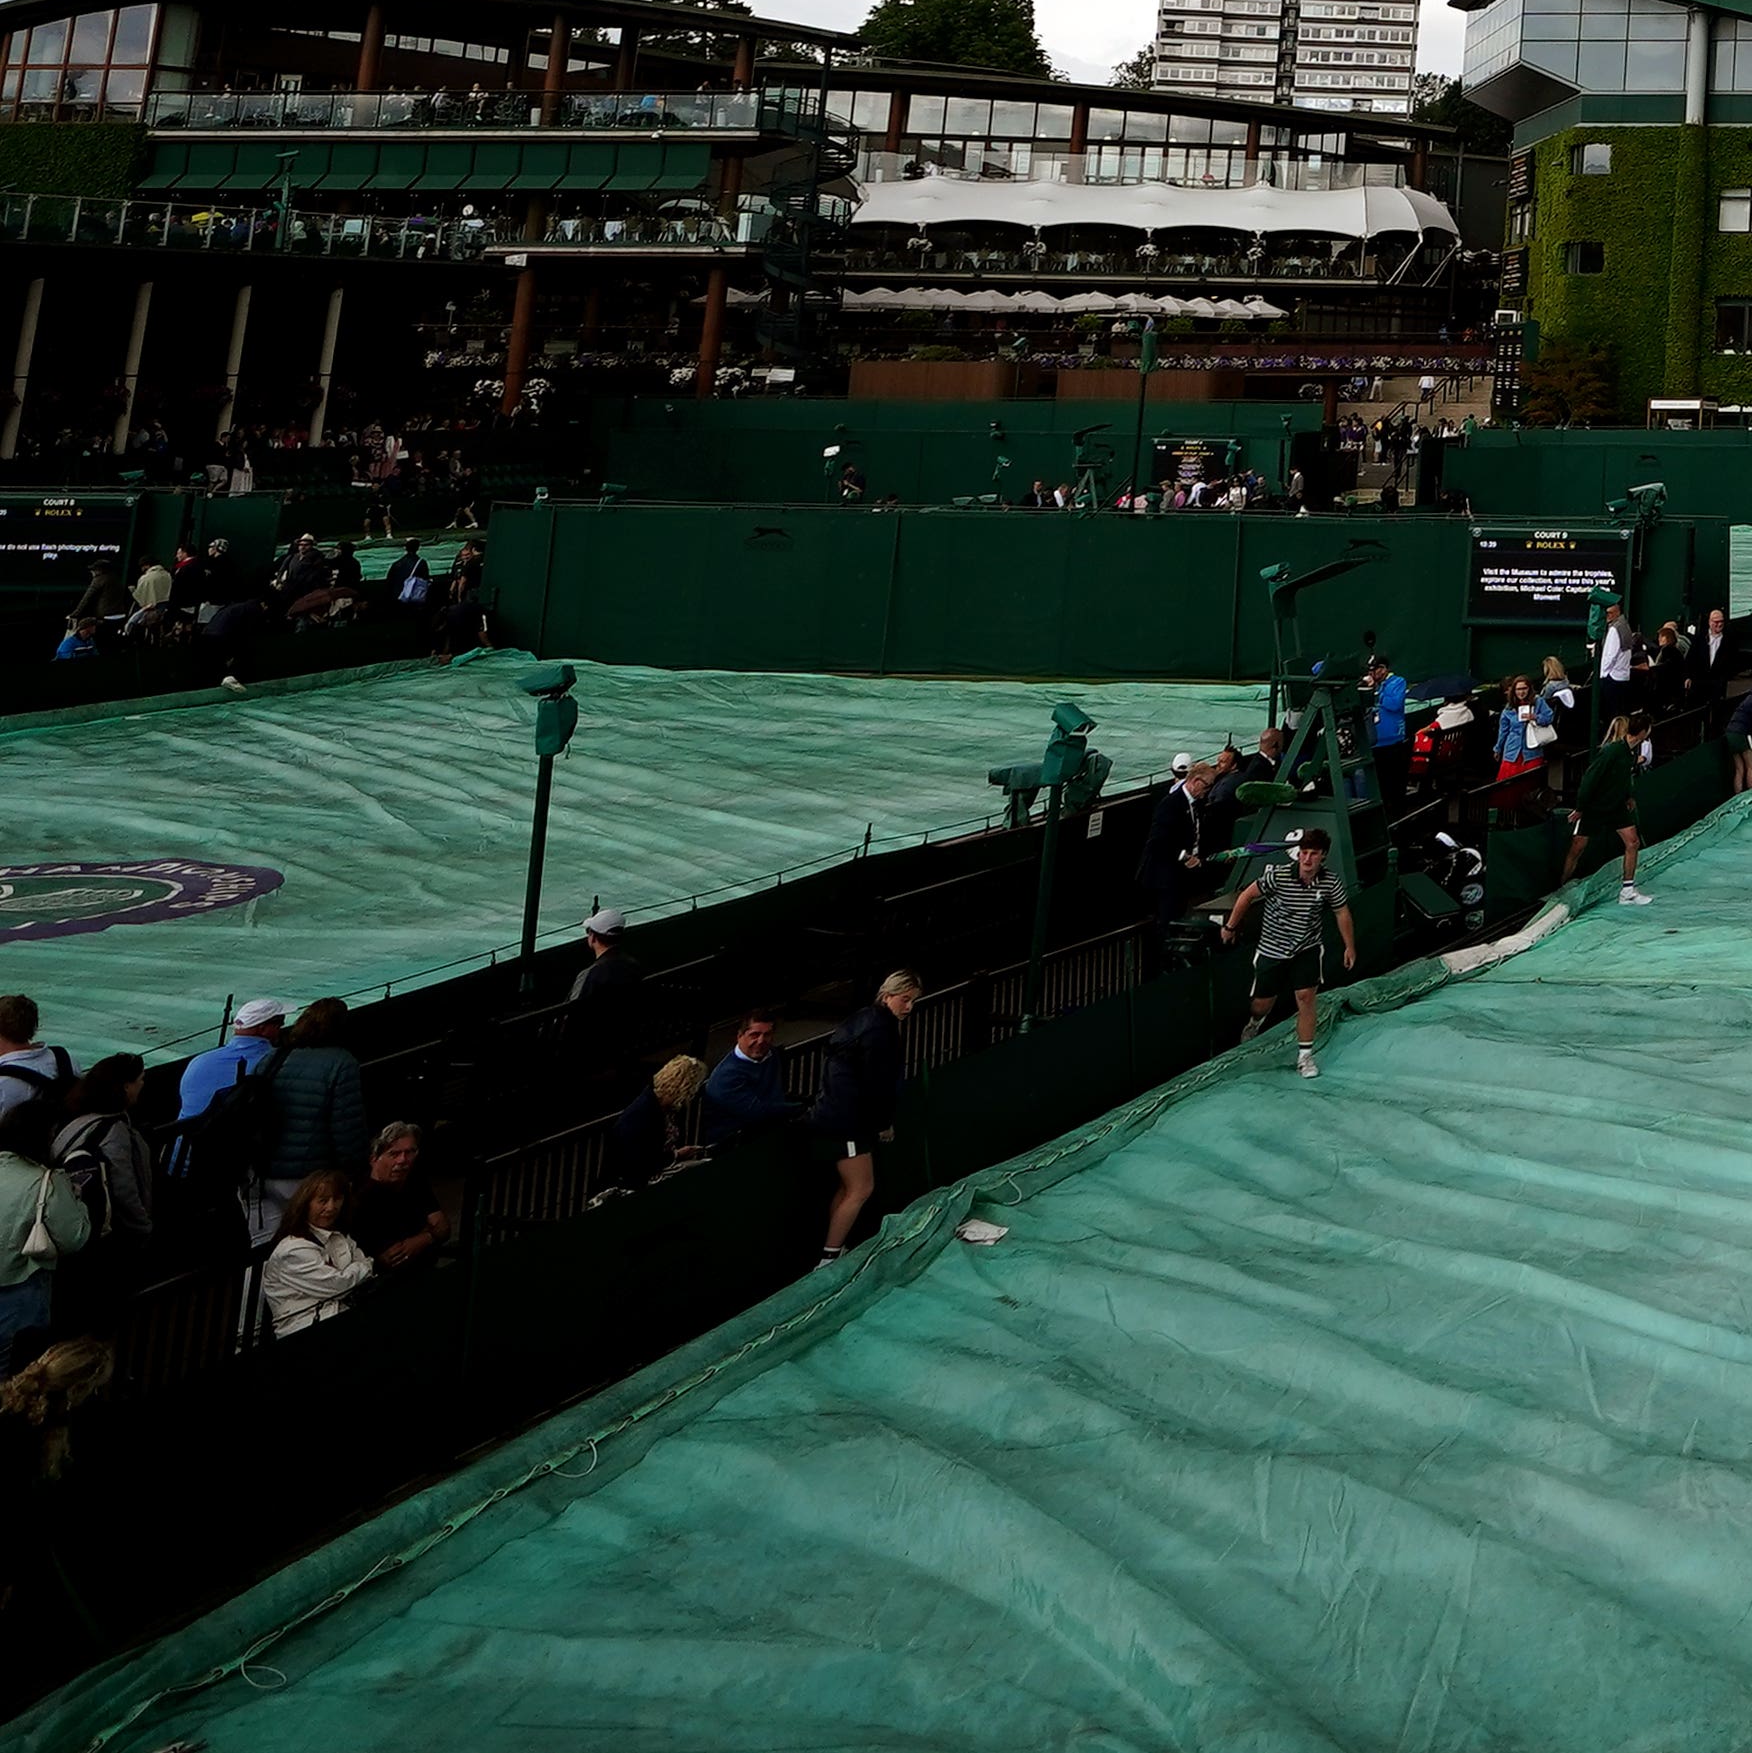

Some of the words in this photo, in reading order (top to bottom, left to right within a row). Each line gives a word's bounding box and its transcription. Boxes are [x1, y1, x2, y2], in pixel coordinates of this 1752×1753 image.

[43, 498, 68, 506] COURT
[1534, 531, 1561, 539] COURT
[1561, 531, 1569, 539] 9
[99, 543, 120, 553] during
[1535, 541, 1565, 549] ROLEX
[1482, 568, 1499, 576] Visit
[1499, 568, 1510, 576] the
[1511, 568, 1539, 576] Museum
[1572, 568, 1583, 576] the
